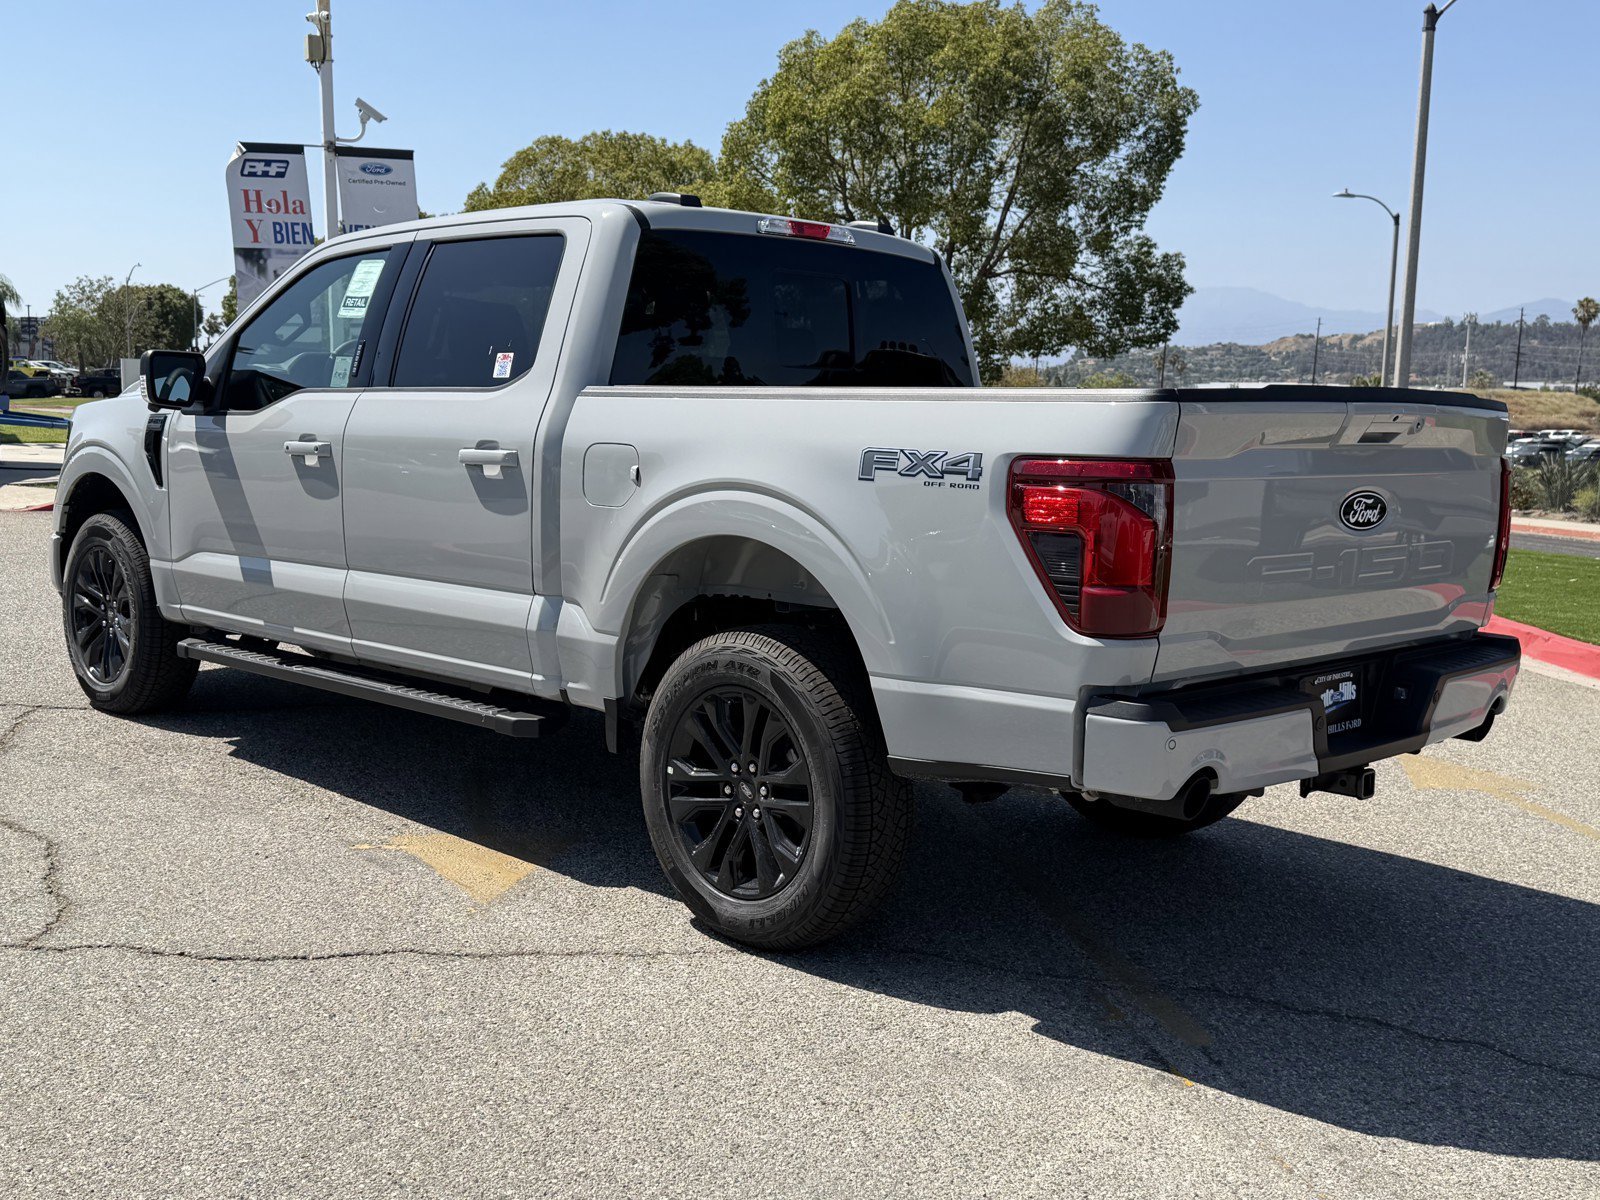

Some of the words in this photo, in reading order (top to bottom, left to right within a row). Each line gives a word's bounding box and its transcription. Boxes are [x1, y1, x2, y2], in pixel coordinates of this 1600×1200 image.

[243, 161, 289, 177] PHF
[365, 164, 386, 173] Ford
[241, 189, 306, 215] Hola
[243, 218, 263, 244] Y
[272, 221, 315, 245] BIEN
[345, 297, 366, 307] RETAIL
[858, 447, 983, 481] FX4
[949, 482, 980, 490] ROAD
[1348, 497, 1382, 523] Ford
[1246, 540, 1455, 598] F-150
[1327, 721, 1345, 735] HILLS
[1345, 718, 1361, 730] FORD
